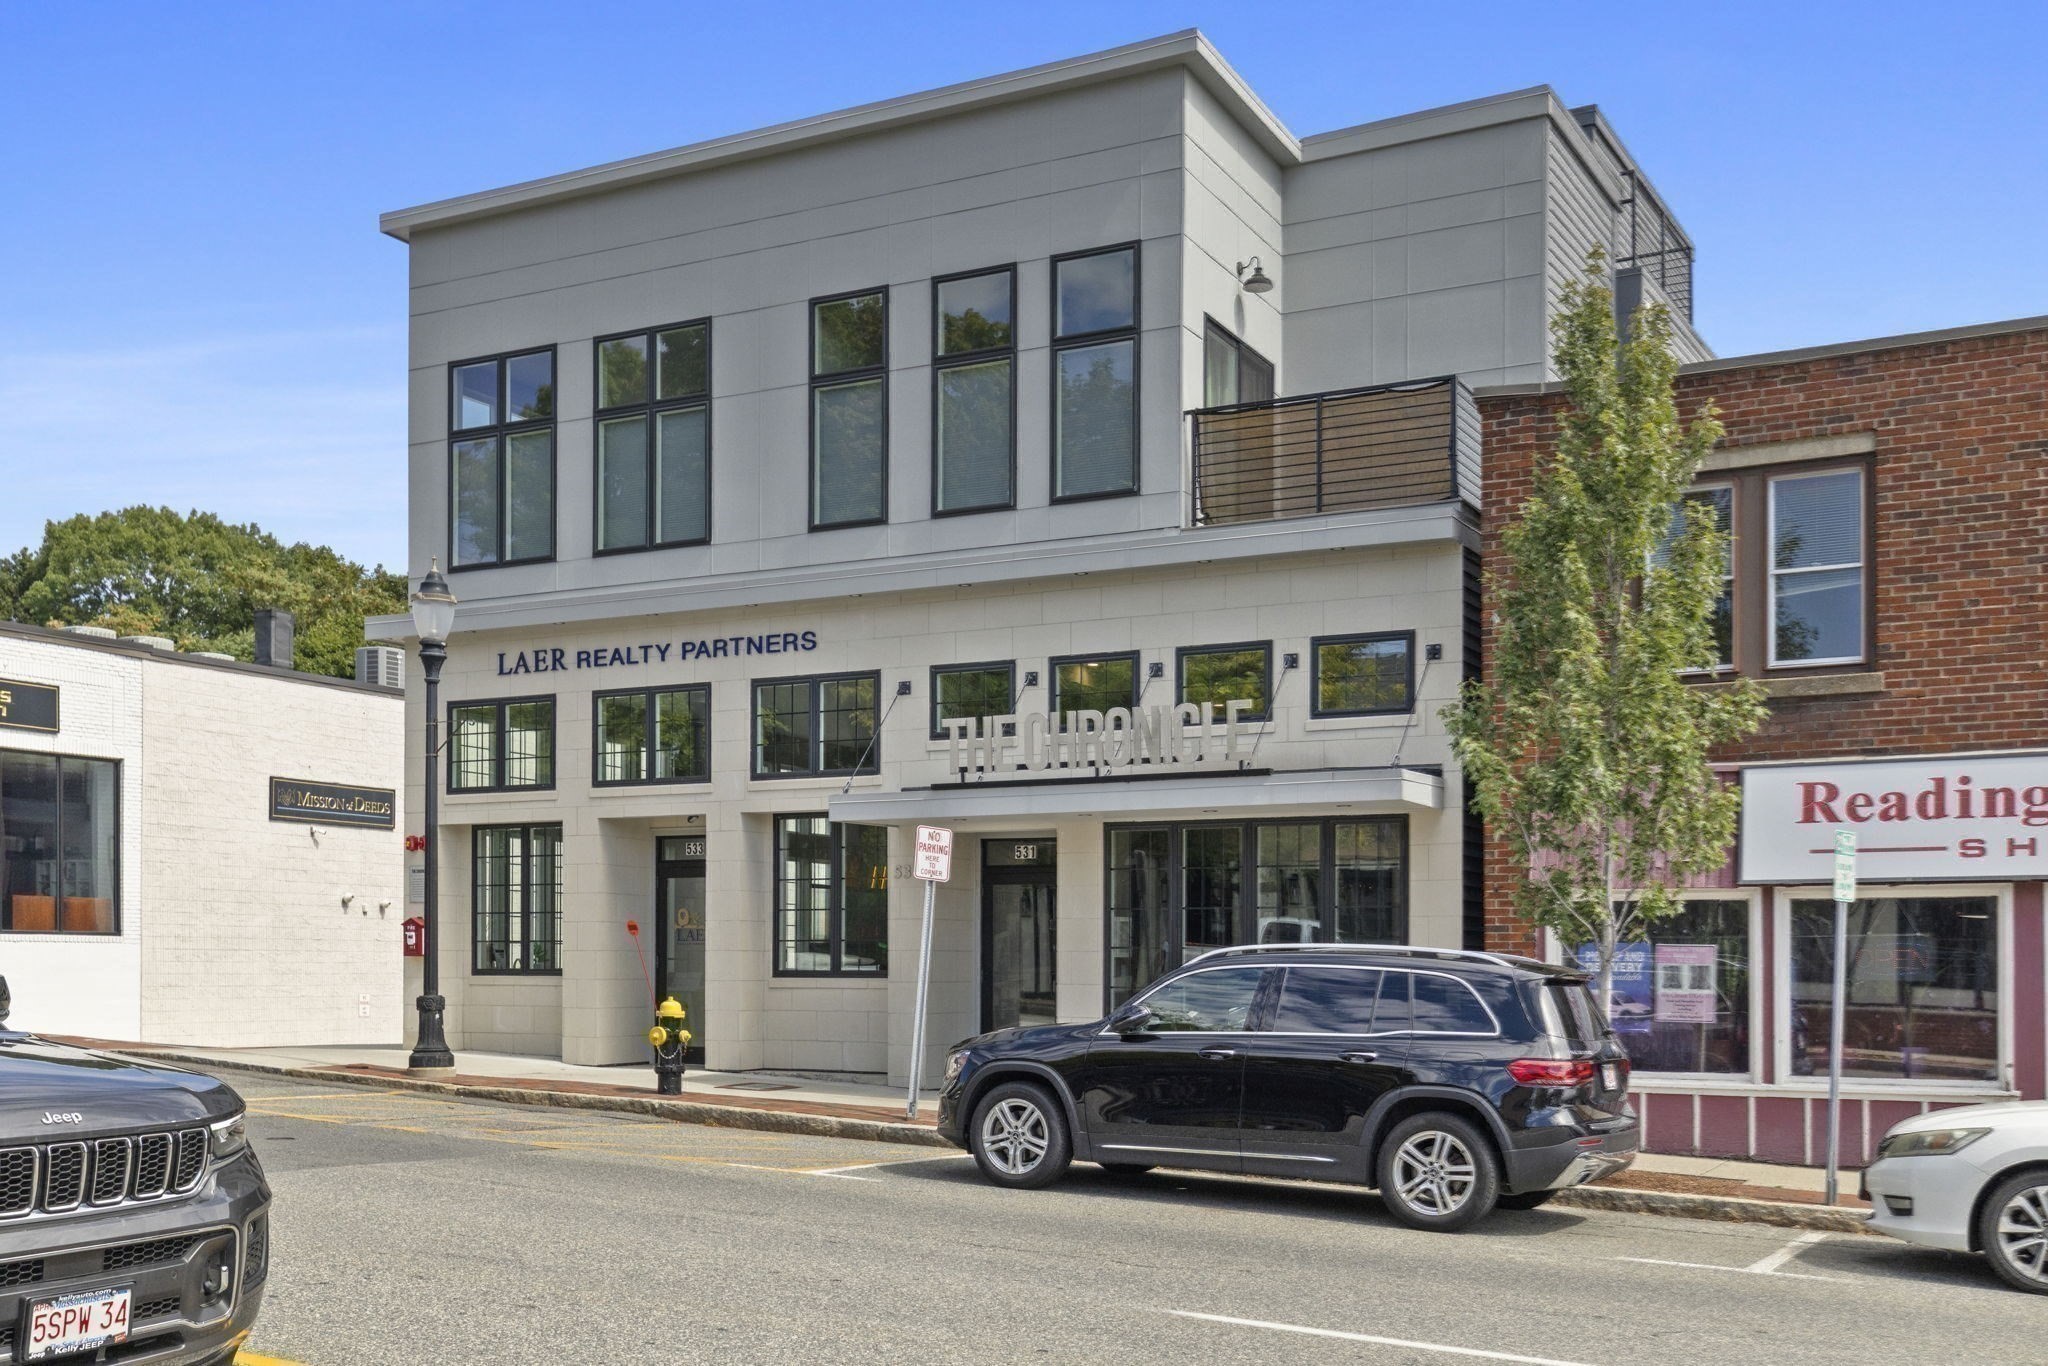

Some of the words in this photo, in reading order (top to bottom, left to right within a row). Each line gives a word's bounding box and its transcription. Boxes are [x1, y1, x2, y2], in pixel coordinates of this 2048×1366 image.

[497, 648, 568, 676] LAER
[576, 643, 671, 669] REALTY
[681, 631, 817, 660] PARTNERS
[942, 713, 1017, 775] THE
[1023, 699, 1252, 771] CHRONICLE
[297, 790, 345, 811] MISSION
[354, 796, 391, 815] DEEDS
[1794, 775, 2048, 827] Reading
[928, 831, 941, 842] NO
[686, 842, 704, 855] 533
[918, 842, 949, 855] PARKING
[1015, 845, 1036, 859] 531
[894, 864, 912, 879] 53
[920, 868, 943, 877] CORNER
[676, 928, 705, 942] LAE
[1856, 948, 1928, 970] OPEN
[1585, 962, 1642, 971] DEVERY
[41, 1111, 83, 1124] Jeep
[58, 1288, 112, 1302] kellyauto.com
[34, 1304, 91, 1343] 5SPW
[100, 1298, 127, 1329] 34
[54, 1345, 79, 1355] Kelly
[80, 1340, 104, 1351] JEEP
